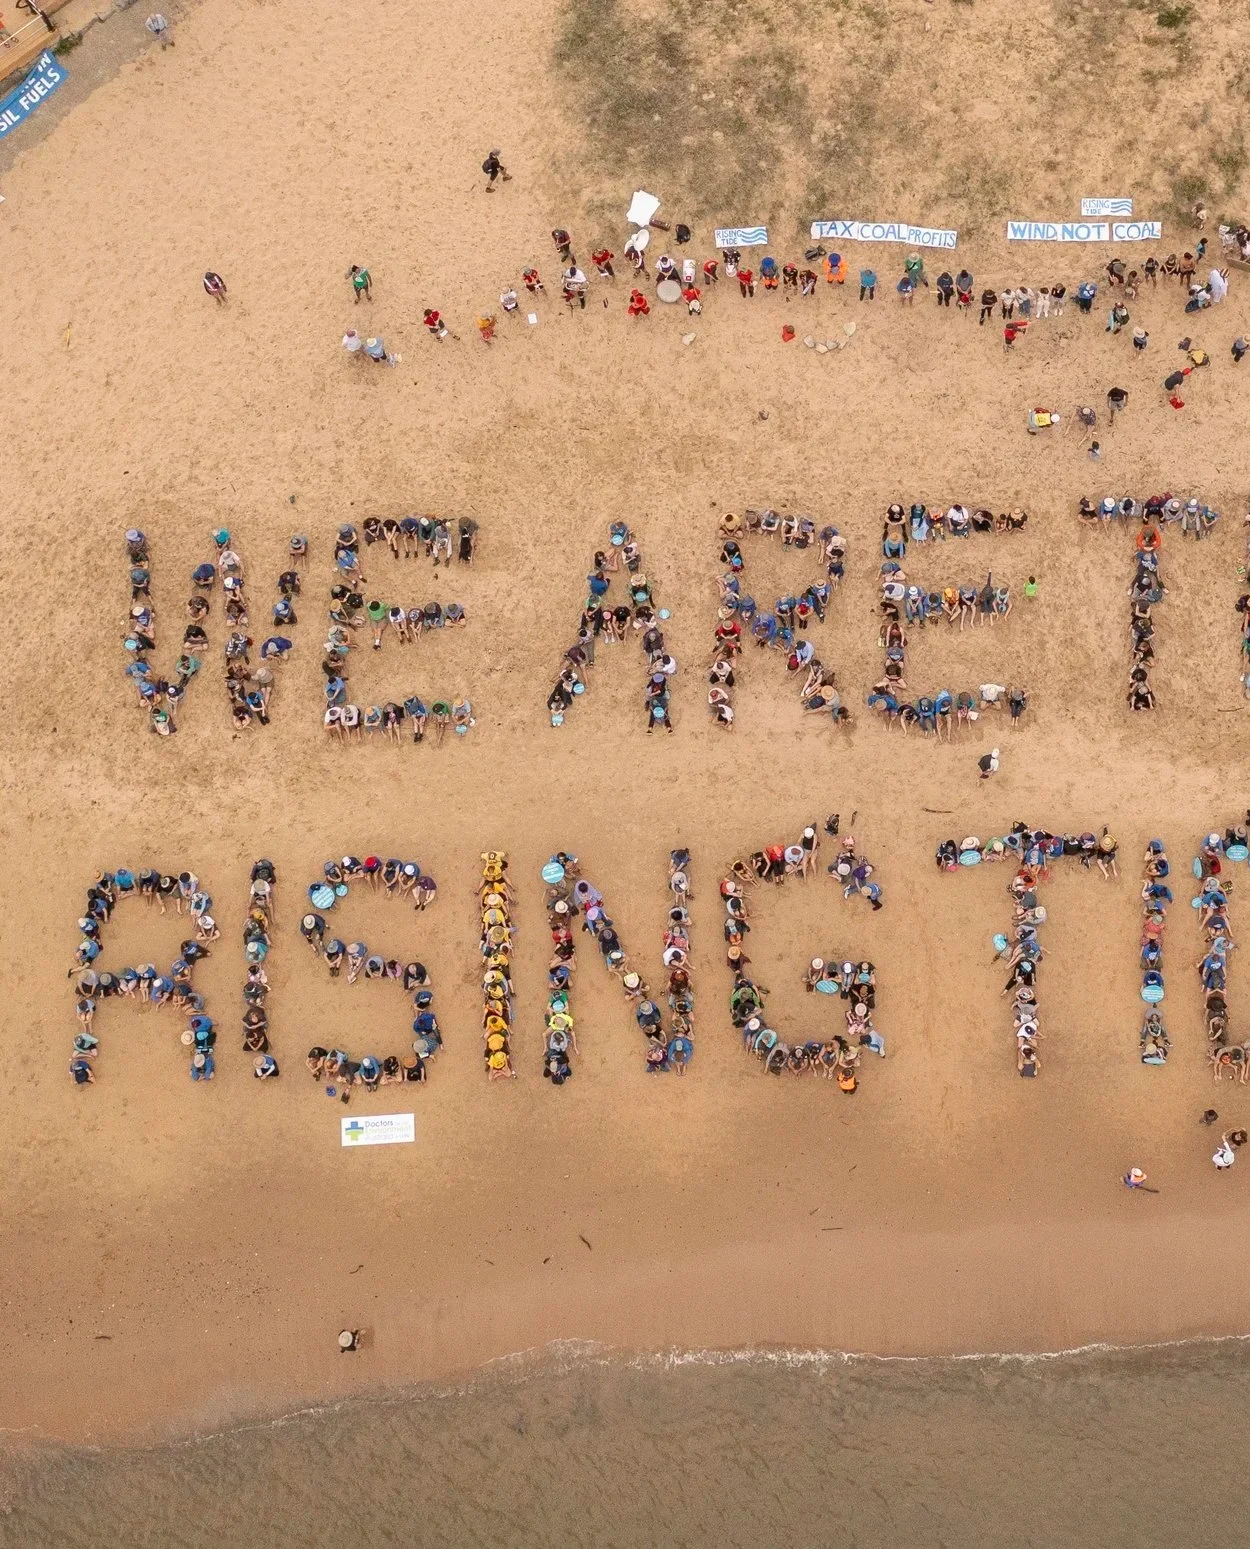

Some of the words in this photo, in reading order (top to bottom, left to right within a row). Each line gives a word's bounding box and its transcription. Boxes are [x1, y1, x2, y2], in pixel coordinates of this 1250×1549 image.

[19, 68, 61, 111] FUELS
[1082, 199, 1110, 208] RISING
[716, 229, 741, 239] RISING
[815, 221, 855, 237] TAX
[860, 223, 907, 240] COAL
[907, 228, 956, 248] PROFITS
[1010, 222, 1057, 240] WIND
[1061, 223, 1106, 241] NOT
[1114, 222, 1160, 240] COAL
[720, 238, 738, 246] TIDE
[364, 1120, 394, 1128] Doctors
